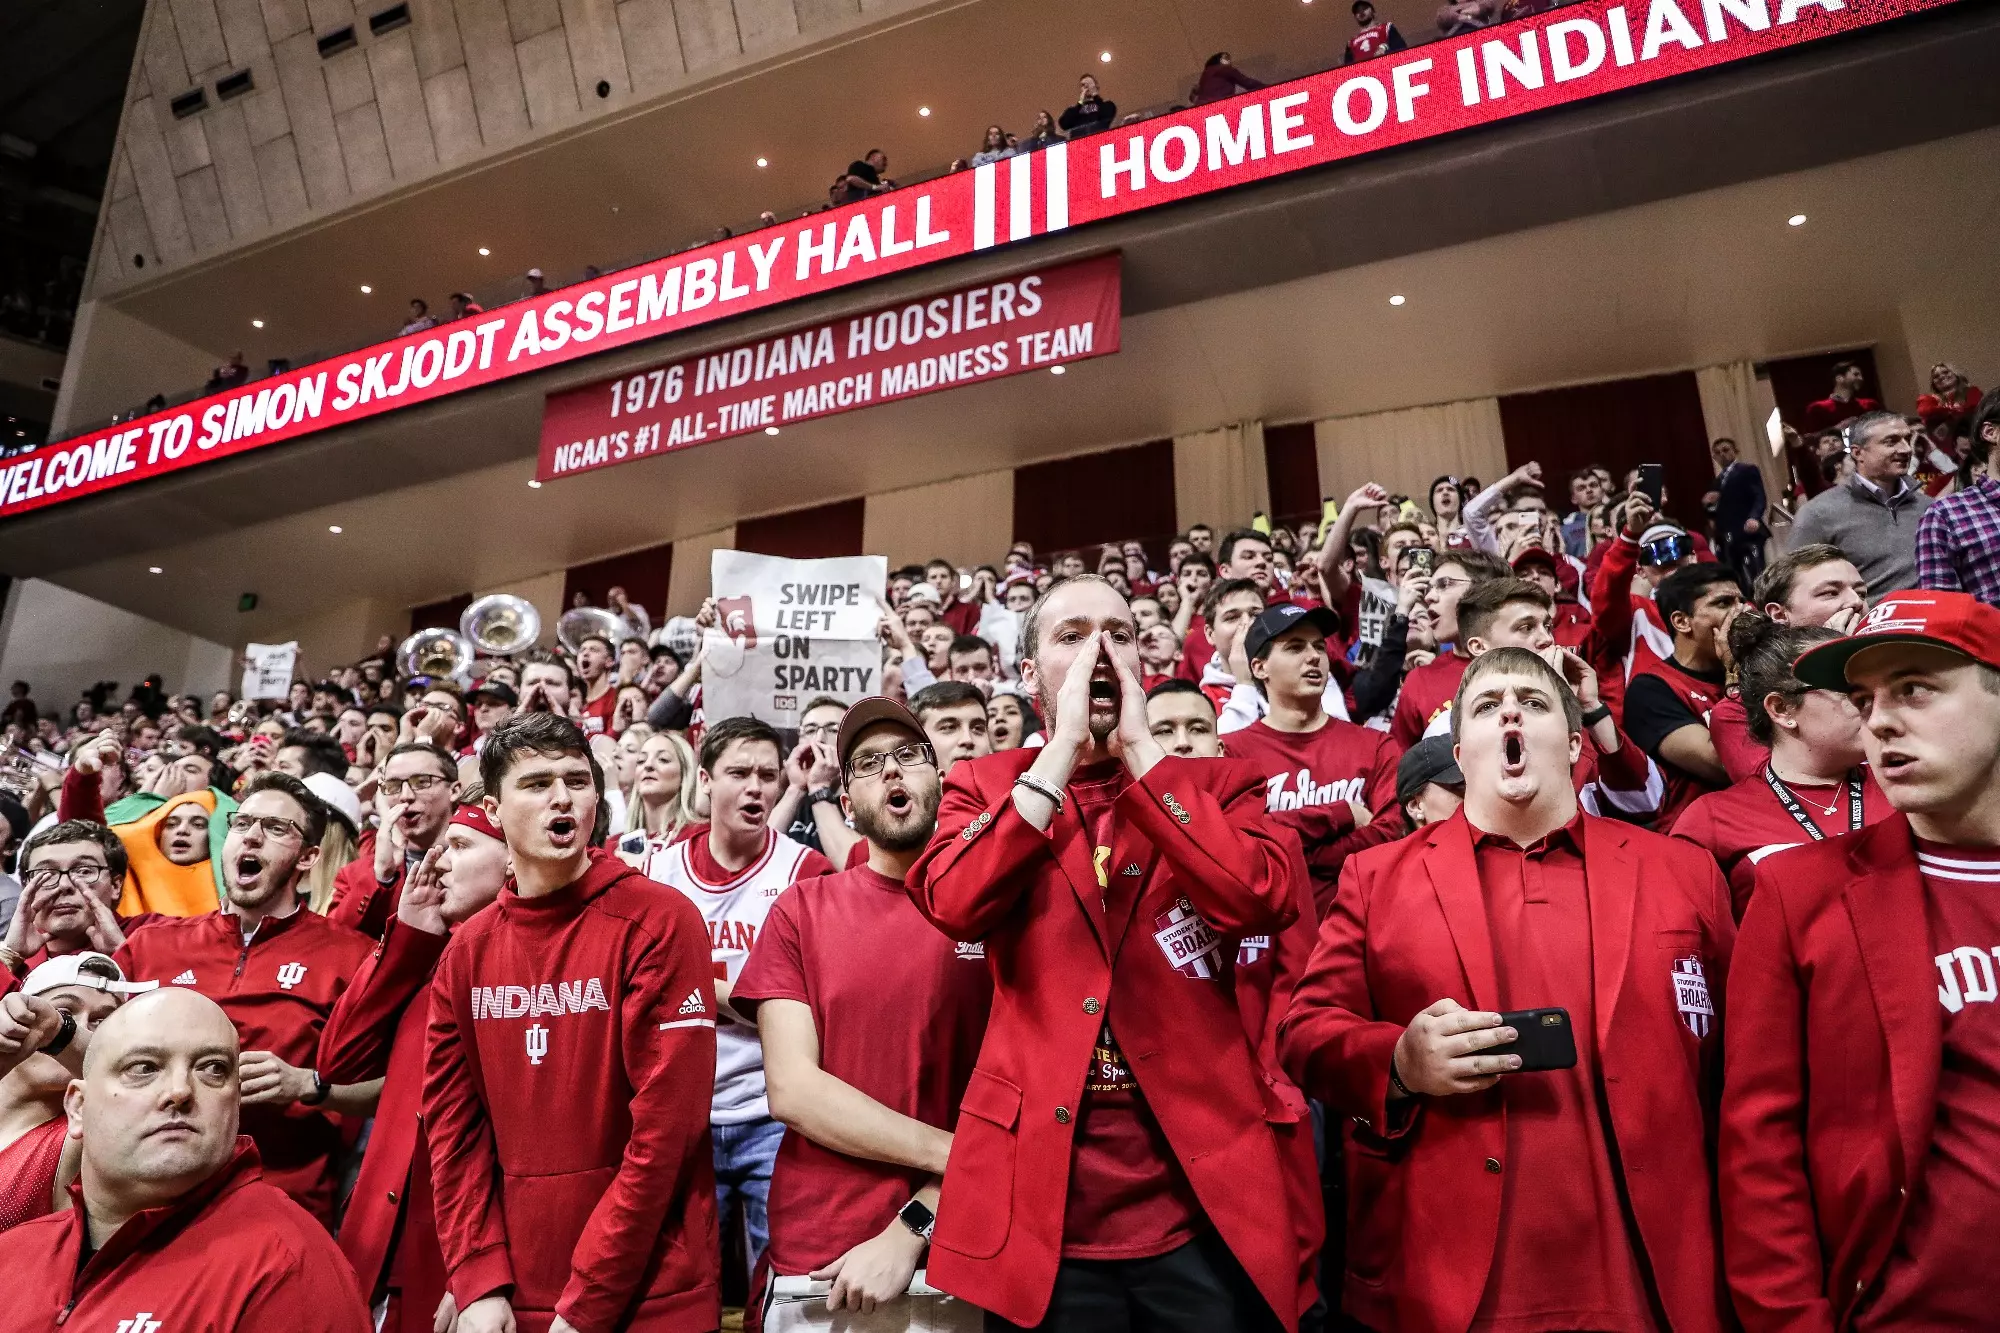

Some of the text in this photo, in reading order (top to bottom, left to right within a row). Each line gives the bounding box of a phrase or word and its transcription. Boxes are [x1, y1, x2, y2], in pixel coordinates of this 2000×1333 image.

[1100, 91, 1315, 198] HOME
[1332, 58, 1433, 136] OF
[148, 414, 193, 465] TO
[198, 372, 328, 450] SIMON
[332, 318, 506, 423] SKJODT
[508, 237, 786, 362] ASSEMBLY
[796, 194, 950, 281] HALL
[610, 276, 1043, 418] 1976 INDIANA HOOSIERS
[553, 322, 1093, 474] NCAA'S #1 ALL-TIME MARCH MADNESS TEAM
[779, 583, 860, 606] SWIPE
[775, 610, 836, 631] LEFT
[773, 635, 810, 659] ON
[774, 665, 873, 692] SPARTY
[774, 696, 797, 710] IDS
[1162, 922, 1197, 943] STUDENT
[471, 978, 611, 1020] INDIANA
[678, 1003, 706, 1015] adidas
